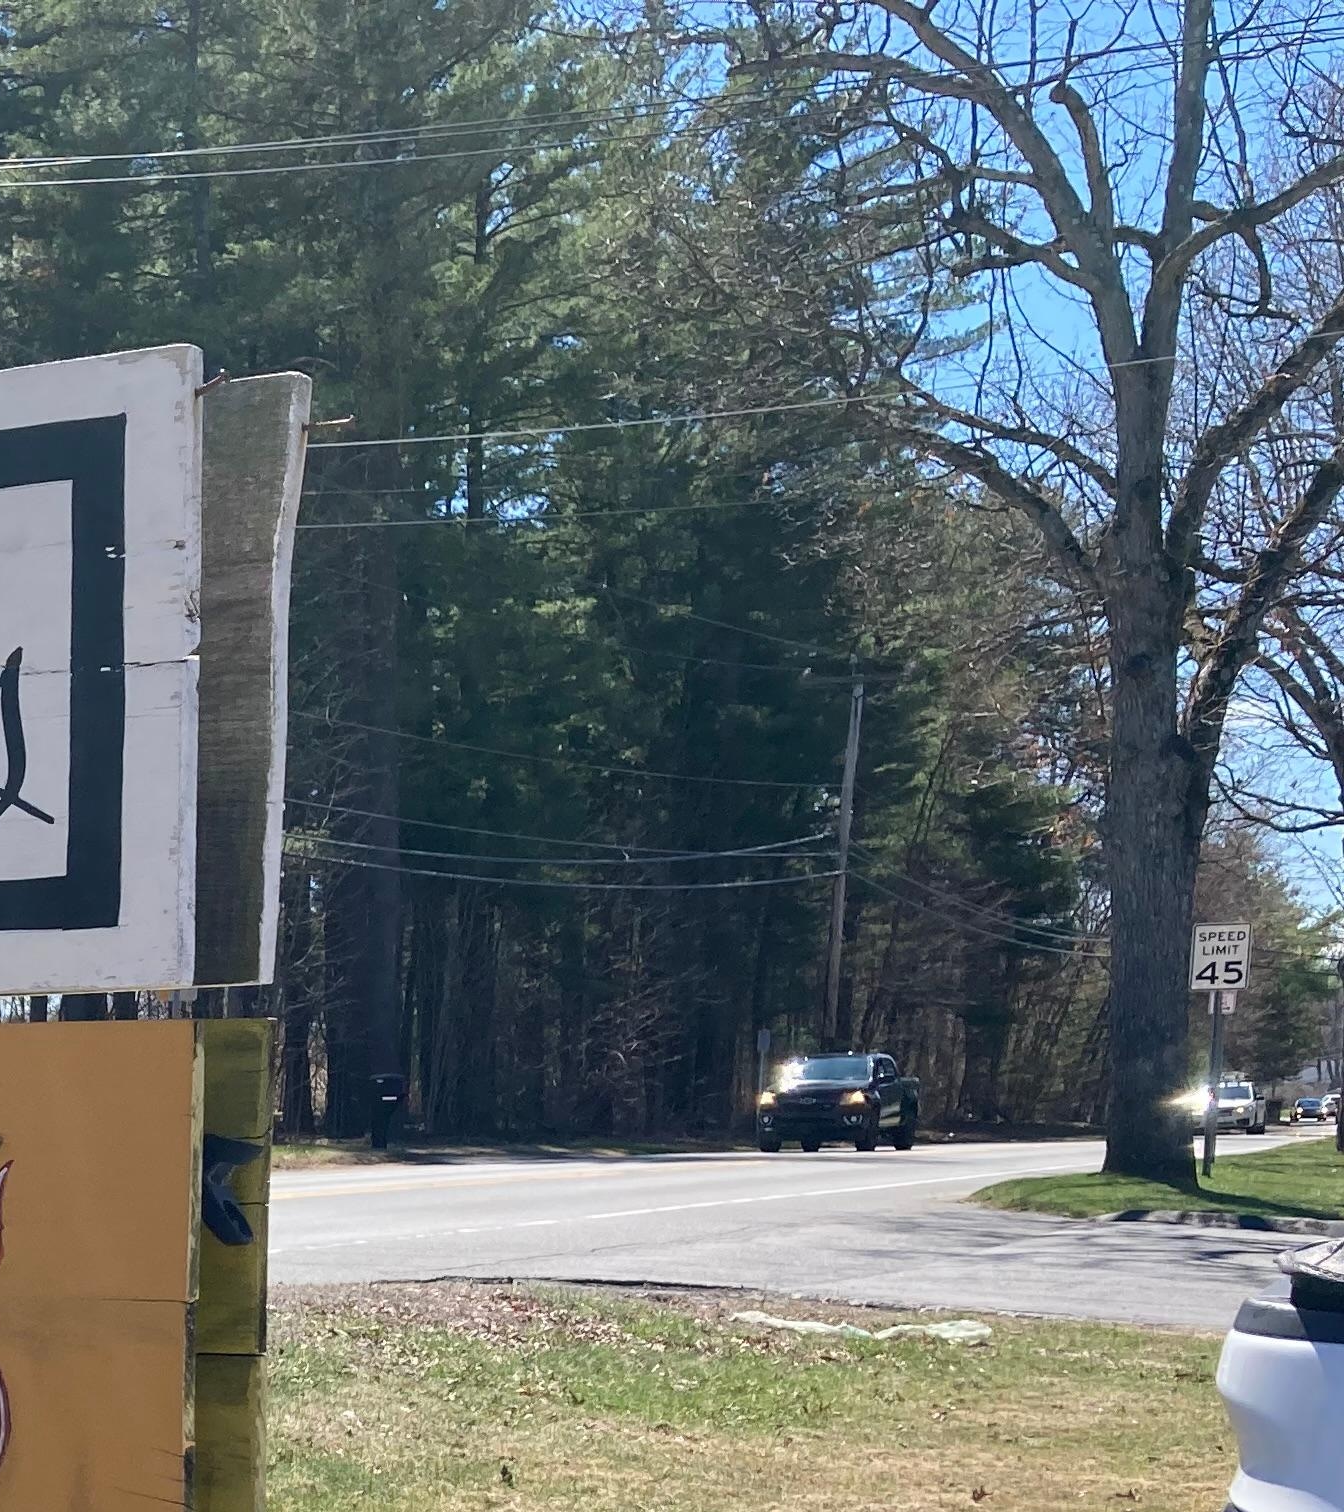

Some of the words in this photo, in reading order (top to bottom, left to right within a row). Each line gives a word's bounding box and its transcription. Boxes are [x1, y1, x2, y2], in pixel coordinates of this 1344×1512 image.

[1198, 930, 1247, 943] SPEED
[1202, 944, 1240, 956] LIMIT
[1195, 960, 1243, 985] 45
